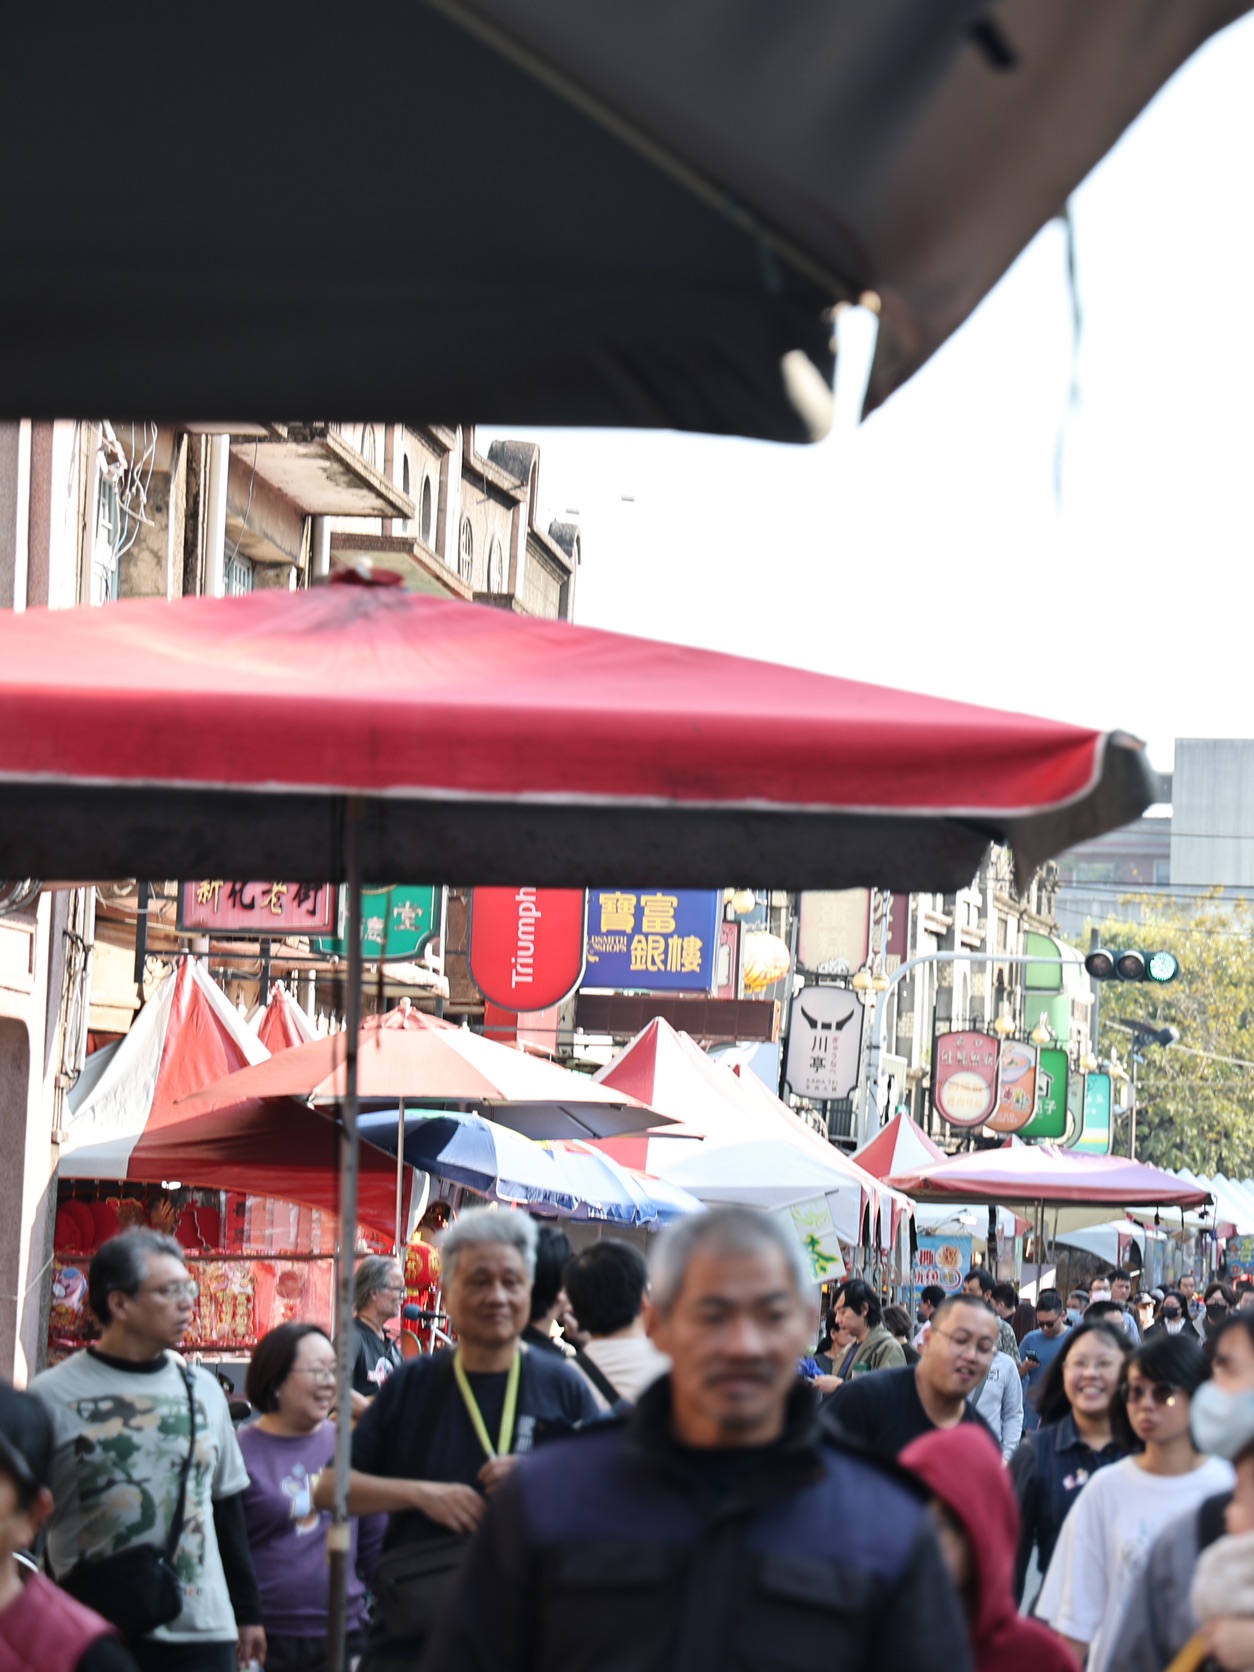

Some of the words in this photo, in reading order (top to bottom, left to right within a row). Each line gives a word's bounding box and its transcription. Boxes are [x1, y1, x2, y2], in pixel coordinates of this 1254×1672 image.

[599, 891, 678, 934] 寶富
[511, 886, 541, 988] Triumph
[630, 934, 702, 973] 銀樓
[809, 1035, 828, 1074] 川亭
